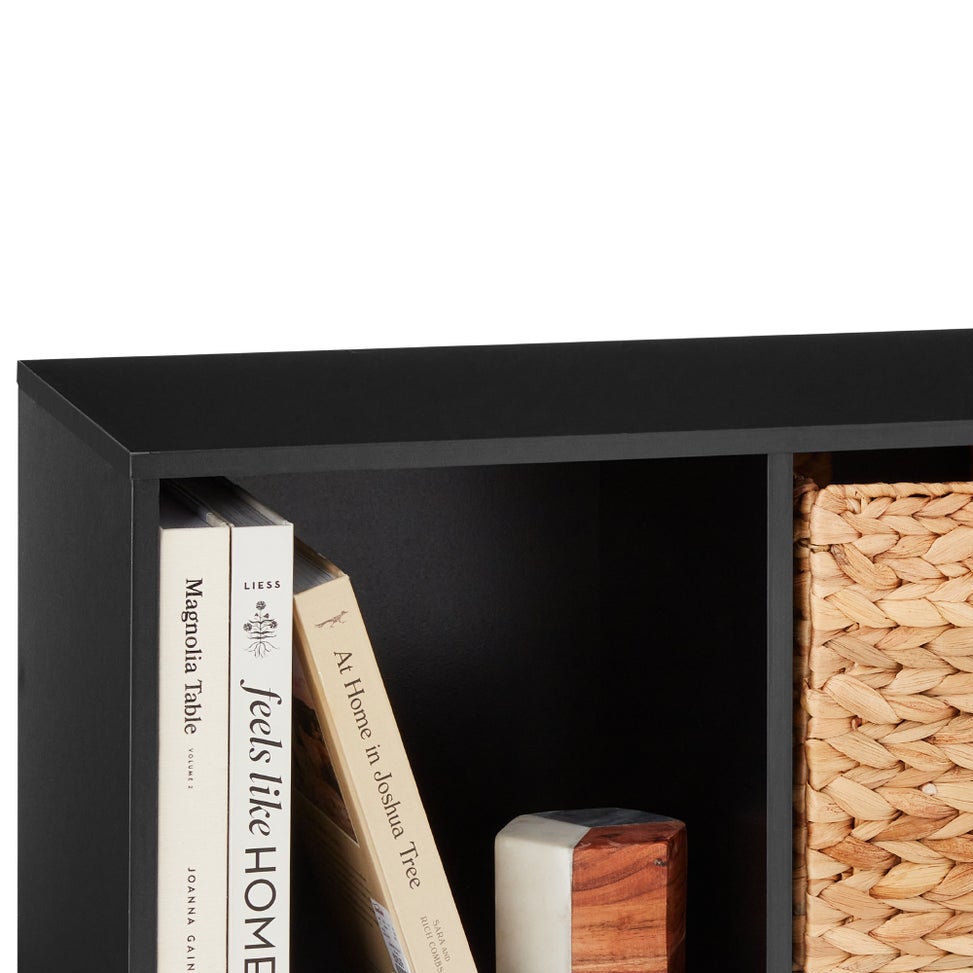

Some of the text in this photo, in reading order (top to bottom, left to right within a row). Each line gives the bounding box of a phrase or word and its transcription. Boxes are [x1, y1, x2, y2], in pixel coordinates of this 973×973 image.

[244, 580, 281, 590] LIESS
[181, 578, 203, 735] Magnolia Table
[240, 678, 283, 764] feels
[187, 747, 195, 782] VOLUME
[333, 651, 421, 890] At Home in Joshua Tree
[249, 772, 283, 837] like
[187, 867, 196, 925] JOANNA
[420, 915, 444, 973] RICH COMBS
[433, 919, 446, 946] SARA
